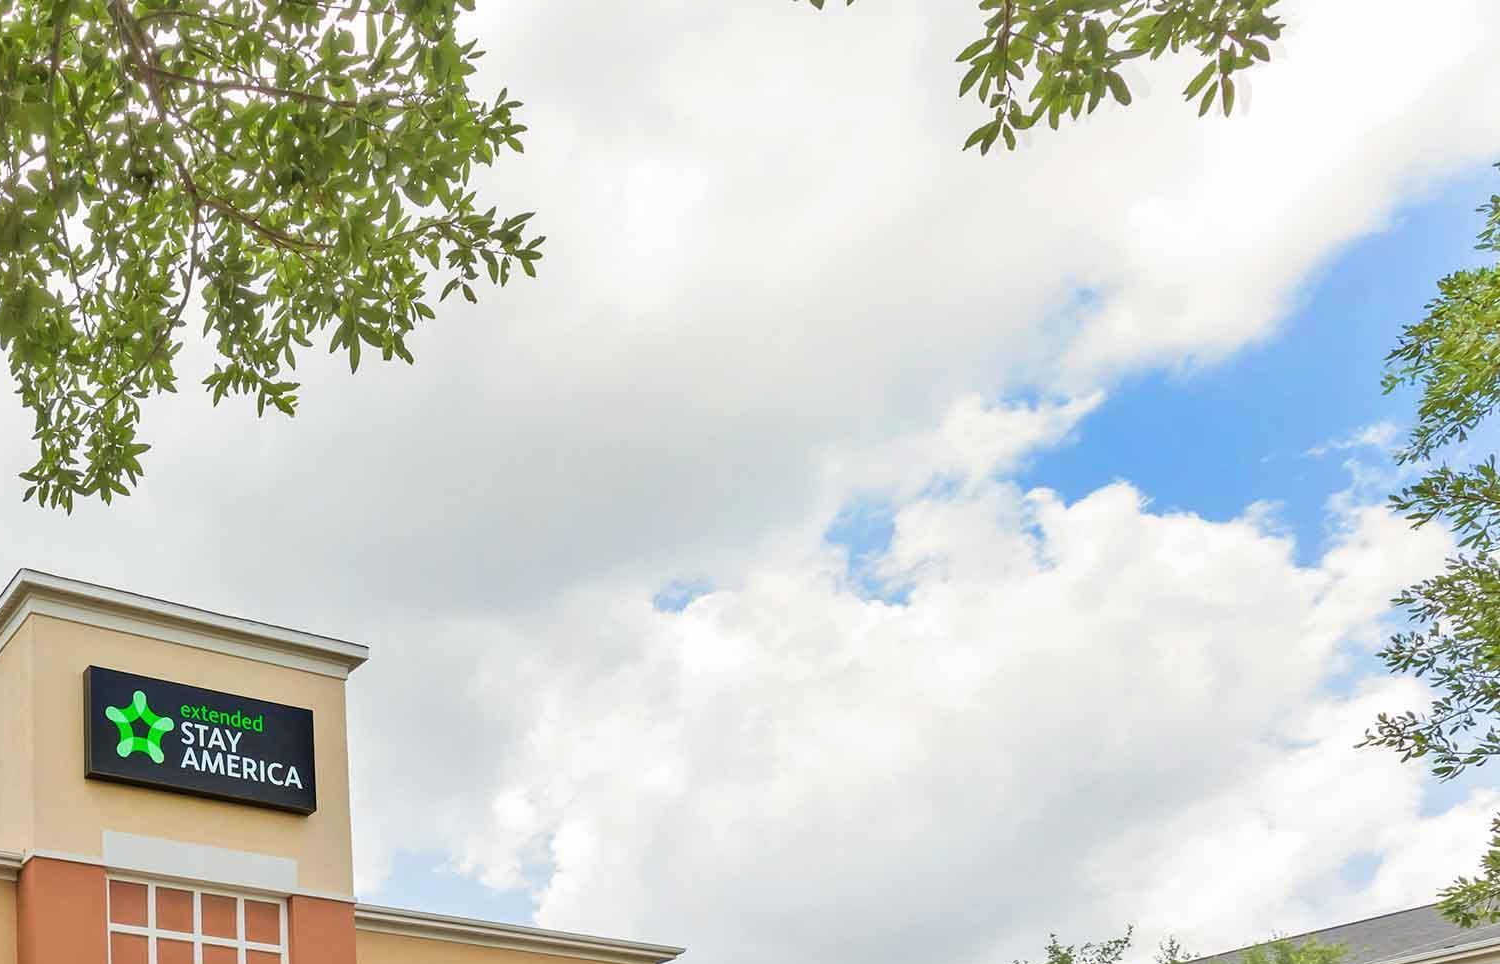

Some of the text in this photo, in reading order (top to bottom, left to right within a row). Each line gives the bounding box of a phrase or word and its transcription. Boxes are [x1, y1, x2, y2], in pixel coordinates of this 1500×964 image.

[180, 704, 264, 732] extended
[180, 722, 243, 753] STAY
[180, 747, 304, 789] AMERICA
